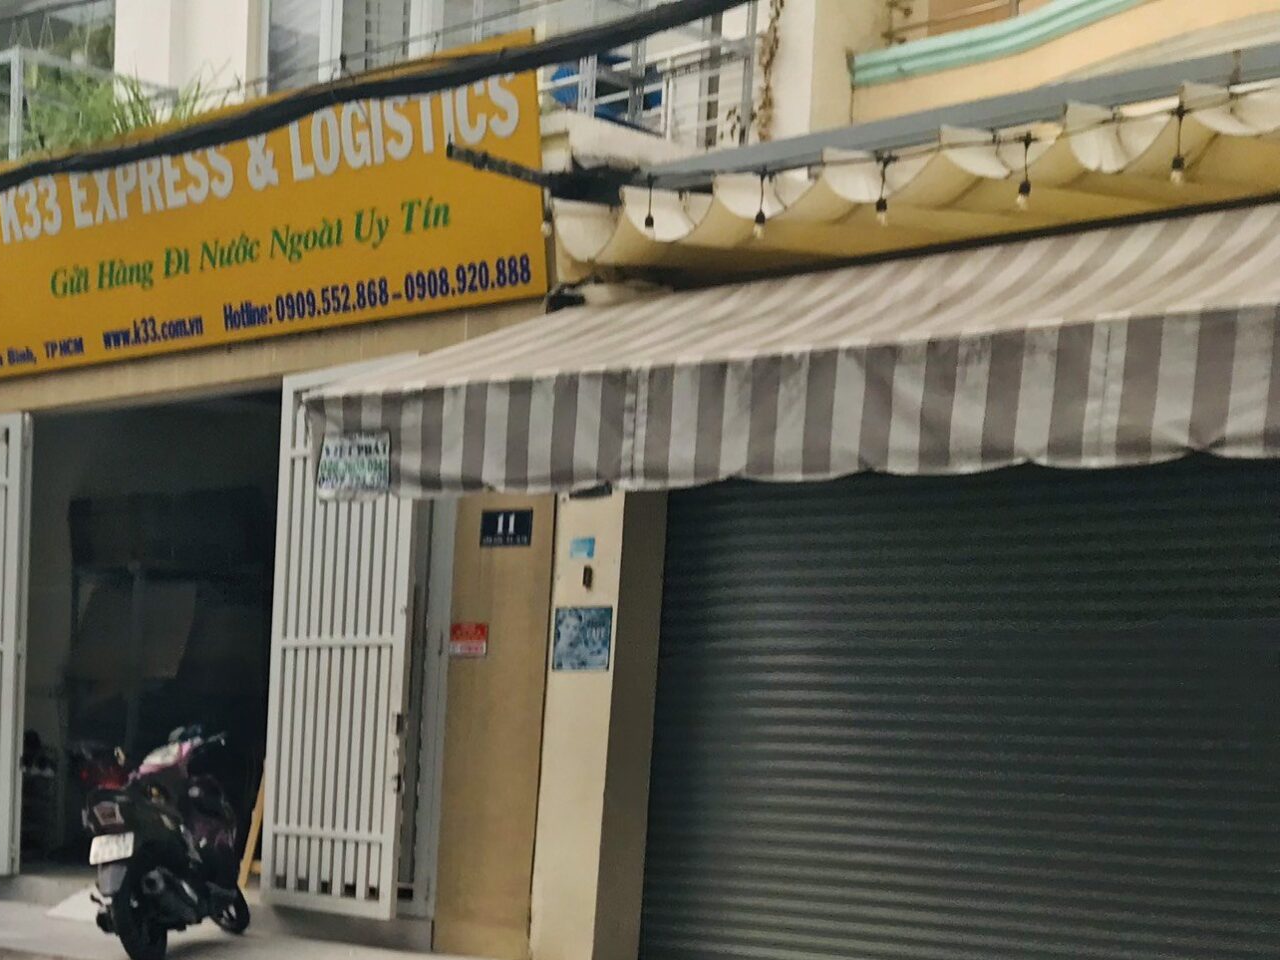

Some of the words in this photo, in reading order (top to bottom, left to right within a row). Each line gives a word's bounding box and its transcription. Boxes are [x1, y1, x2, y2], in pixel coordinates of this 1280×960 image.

[69, 146, 233, 230] EXPRESS
[247, 134, 279, 192] &
[288, 72, 519, 183] LOGISTICS
[97, 258, 154, 291] Hàng
[200, 230, 261, 272] Nước
[354, 206, 390, 249] Uy
[401, 196, 451, 234] Tín
[102, 314, 204, 350] www.k33.com.vn
[223, 299, 273, 331] Hotline:
[404, 253, 532, 303] 0908.920.888
[497, 512, 516, 534] 11
